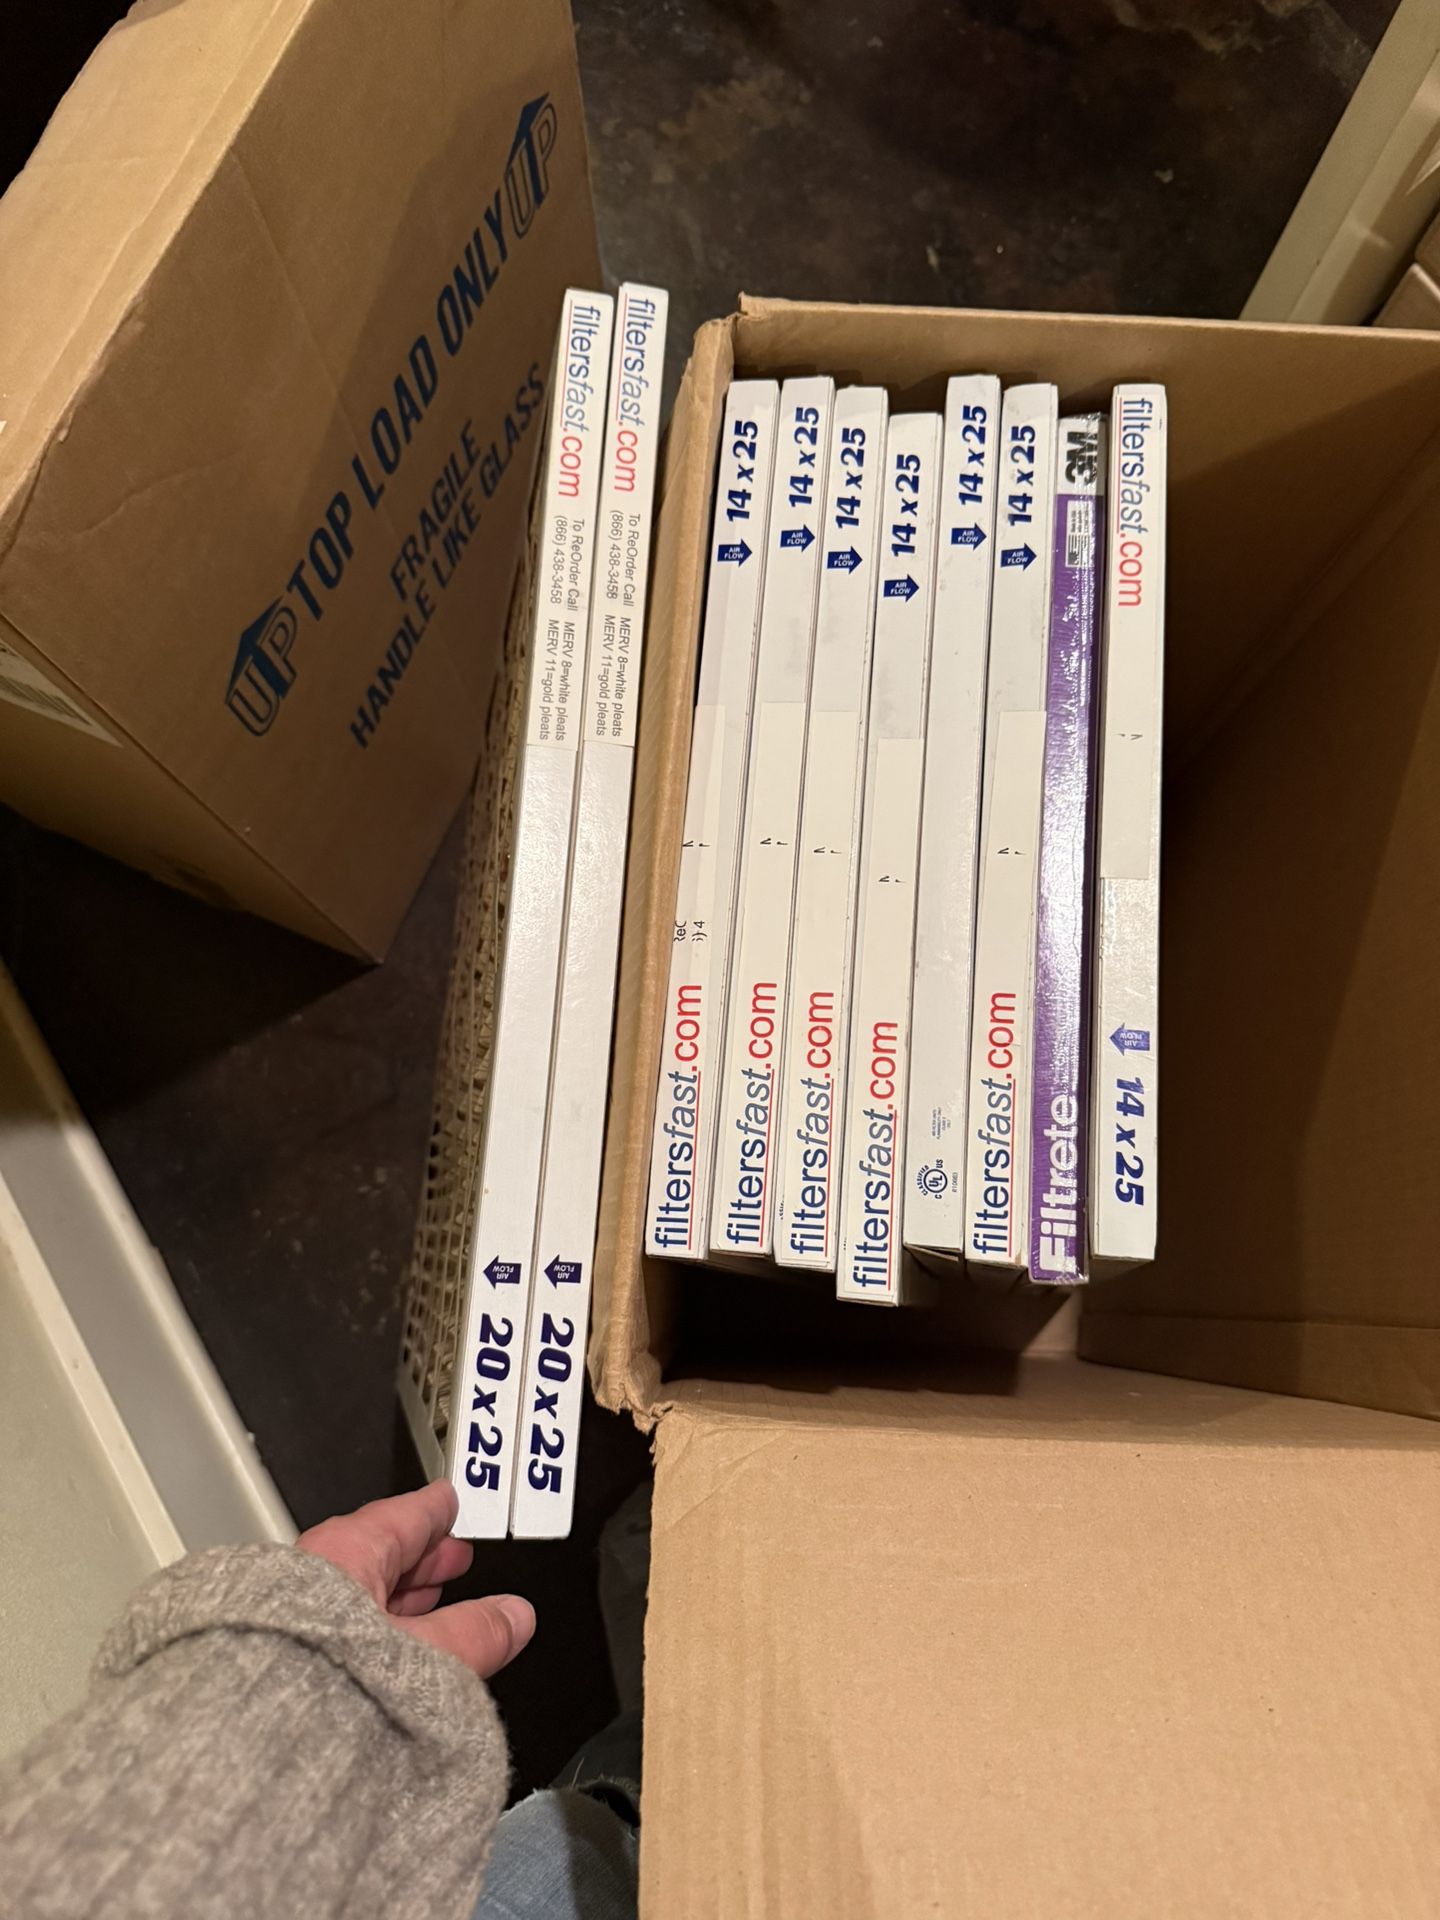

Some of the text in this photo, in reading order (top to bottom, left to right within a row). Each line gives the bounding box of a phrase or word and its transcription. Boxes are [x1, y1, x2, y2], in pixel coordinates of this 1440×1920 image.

[558, 305, 600, 498] filtersfast.com
[614, 298, 656, 493] filtersfast.com
[958, 405, 987, 506] 14 x 25
[225, 604, 298, 736] UP
[287, 491, 354, 621] TOP
[352, 334, 438, 511] LOAD
[437, 188, 507, 357] ONLY
[389, 417, 481, 602] FRAGILE
[727, 420, 758, 522] 14 x 25
[789, 407, 819, 508] 14 x 25
[835, 427, 866, 529] 14 x 25
[891, 454, 921, 557] 14 x 25
[1008, 425, 1036, 527] 14 x 25
[1065, 431, 1098, 486] 3M
[1117, 398, 1153, 607] filtersfast.com
[350, 362, 544, 749] HANDLE LIKE GLASS
[550, 515, 568, 605] (866) 438-3458
[567, 518, 585, 612] To ReOrder Call
[606, 510, 623, 600] (866) 438-3458
[623, 513, 640, 607] To ReOrder Call
[834, 559, 854, 567] FLOW
[890, 587, 911, 595] FLOW
[1007, 556, 1028, 564] FLOW
[539, 619, 559, 741] MERV 11=gold pleats
[555, 621, 575, 741] MERV 8=white pleats
[596, 614, 616, 736] MERV 11=gold pleats
[612, 616, 631, 737] MERV 8=white pleats
[655, 984, 702, 1248] filtersfast.com
[726, 982, 777, 1245] filtersfast.com
[791, 991, 834, 1254] filtersfast.com
[853, 1022, 898, 1287] filtersfast.com
[973, 992, 1017, 1254] filtersfast.com
[1115, 1077, 1144, 1206] 14 x 25
[1039, 1092, 1078, 1274] Filtrete
[492, 1265, 515, 1273] FLOW
[553, 1264, 575, 1272] FLOW
[465, 1312, 513, 1491] 20 x 25
[527, 1312, 575, 1494] 20 x 25
